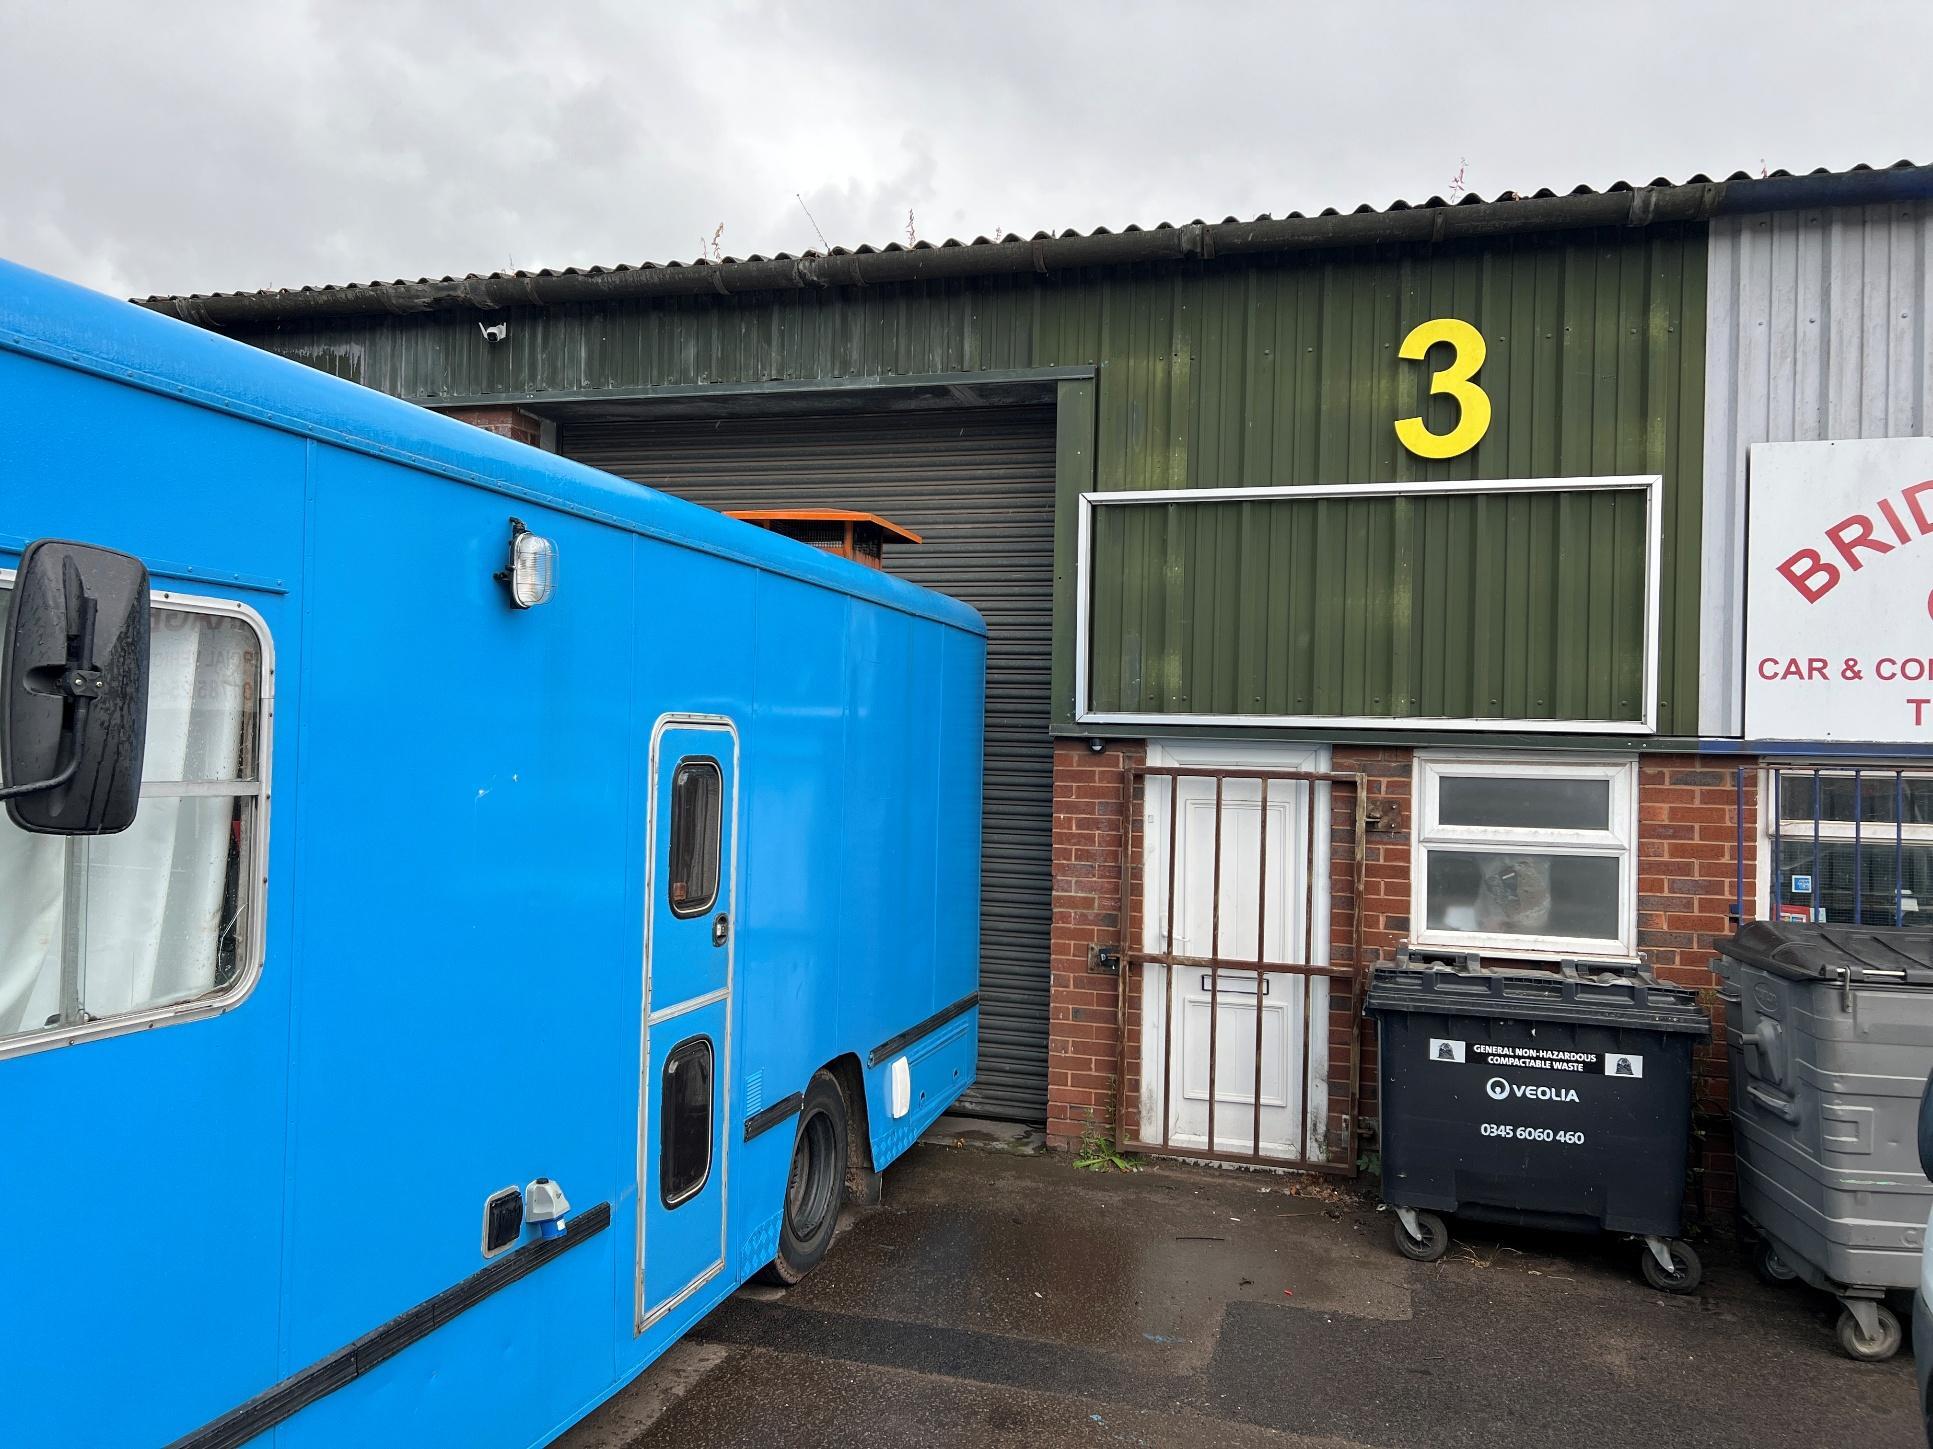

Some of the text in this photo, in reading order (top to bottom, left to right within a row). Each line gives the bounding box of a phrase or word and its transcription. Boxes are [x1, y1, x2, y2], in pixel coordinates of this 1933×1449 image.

[1394, 318, 1492, 459] 3
[1758, 657, 1933, 681] CAR & CO
[1474, 1045, 1596, 1062] GENERAL NON-HAZARDOUS
[1488, 1056, 1584, 1072] COMPACTABLE WASTE
[1512, 1084, 1580, 1103] VEOLIA
[1480, 1123, 1585, 1145] 0345 6060 460
